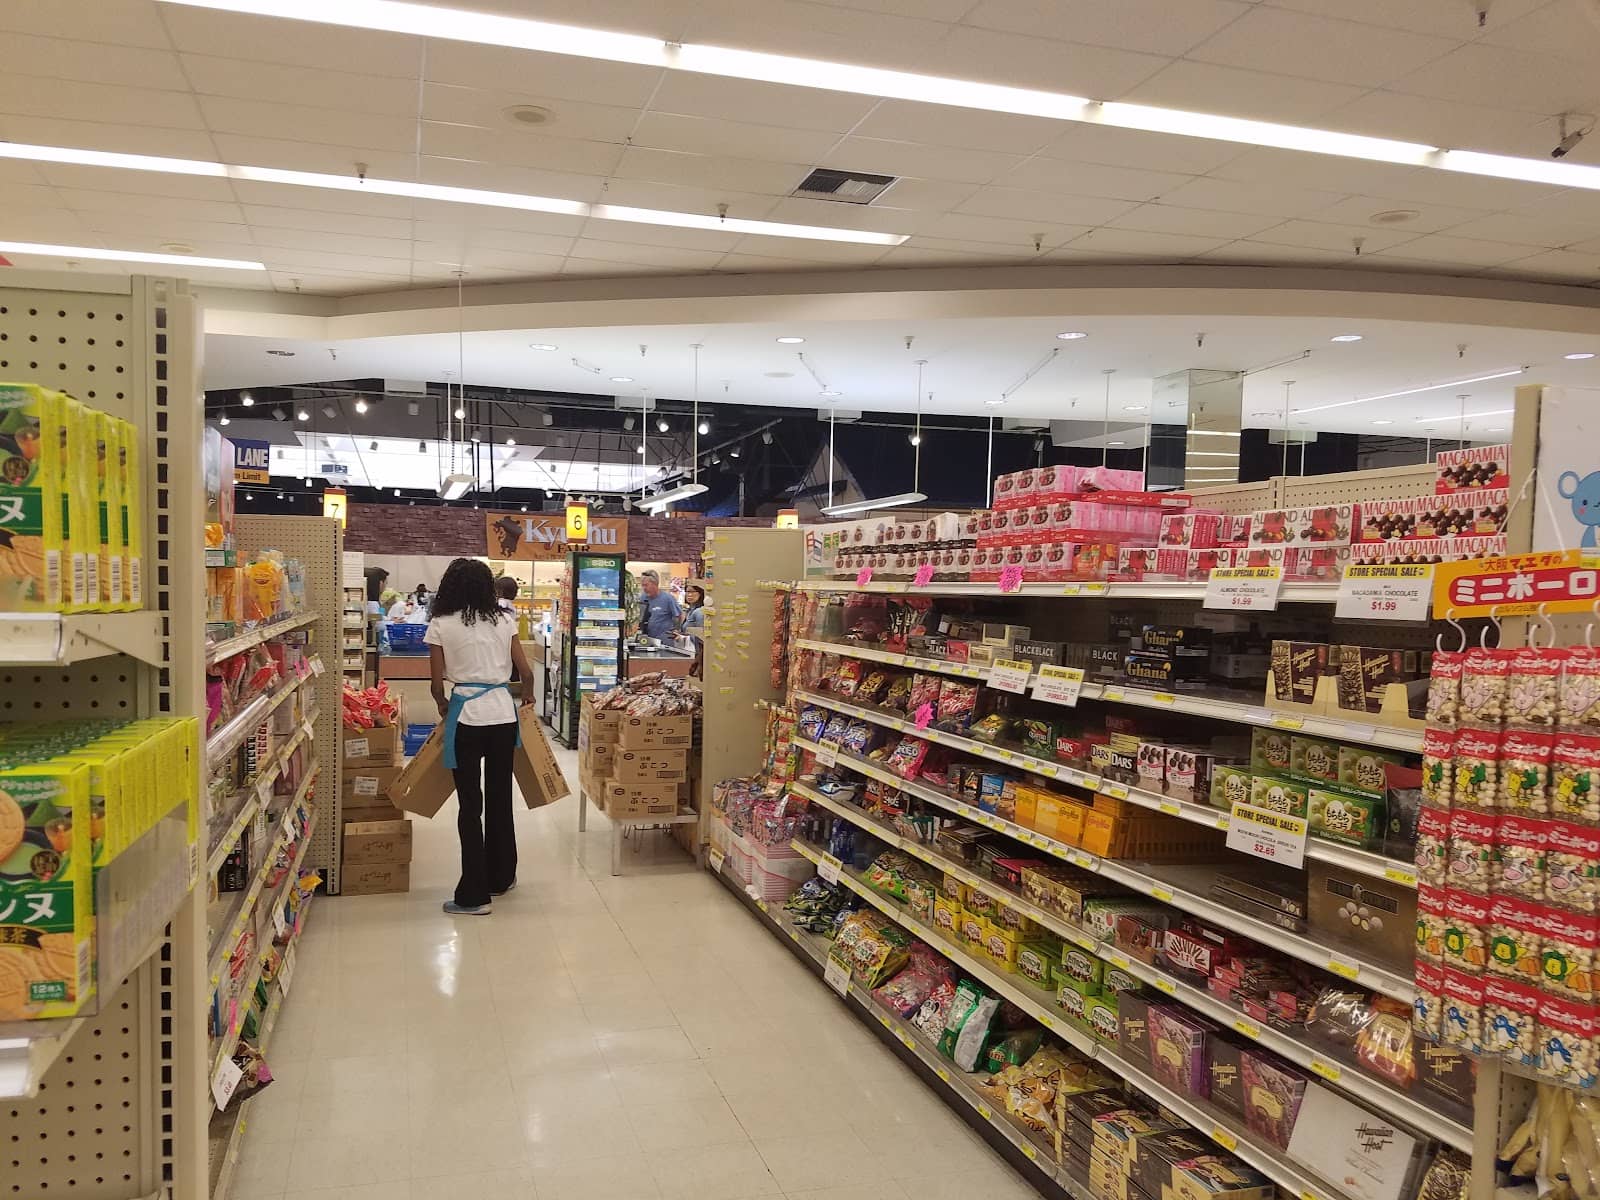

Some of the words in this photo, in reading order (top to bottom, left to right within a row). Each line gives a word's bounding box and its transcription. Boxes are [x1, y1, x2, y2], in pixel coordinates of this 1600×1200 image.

[237, 447, 268, 467] LANE
[1438, 446, 1505, 468] MACADAMIA
[242, 471, 261, 480] Limit
[331, 503, 339, 518] 7
[1254, 510, 1298, 524] ALND
[1301, 506, 1350, 521] ALND
[574, 515, 582, 530] 6
[524, 519, 617, 547] Kyhu
[1388, 540, 1449, 555] MACADAMIA
[1216, 569, 1232, 577] STORE
[1233, 569, 1255, 577] SPECIAL
[1349, 568, 1370, 576] STORE
[1372, 568, 1398, 576] SPECIAL
[1401, 567, 1418, 576] SALE
[1456, 571, 1597, 603] ミニボーロ
[1371, 601, 1397, 611] $1.99
[1144, 630, 1176, 647] Gha
[1092, 649, 1119, 661] BLACK
[1127, 662, 1168, 680] Ghana
[1057, 738, 1073, 753] DARS
[1111, 753, 1132, 769] DARS
[1358, 762, 1380, 777] もちもち
[1237, 808, 1254, 820] STORE
[1256, 813, 1278, 827] SPECIAL
[1280, 819, 1295, 831] SALE
[1326, 807, 1349, 823] もちもち
